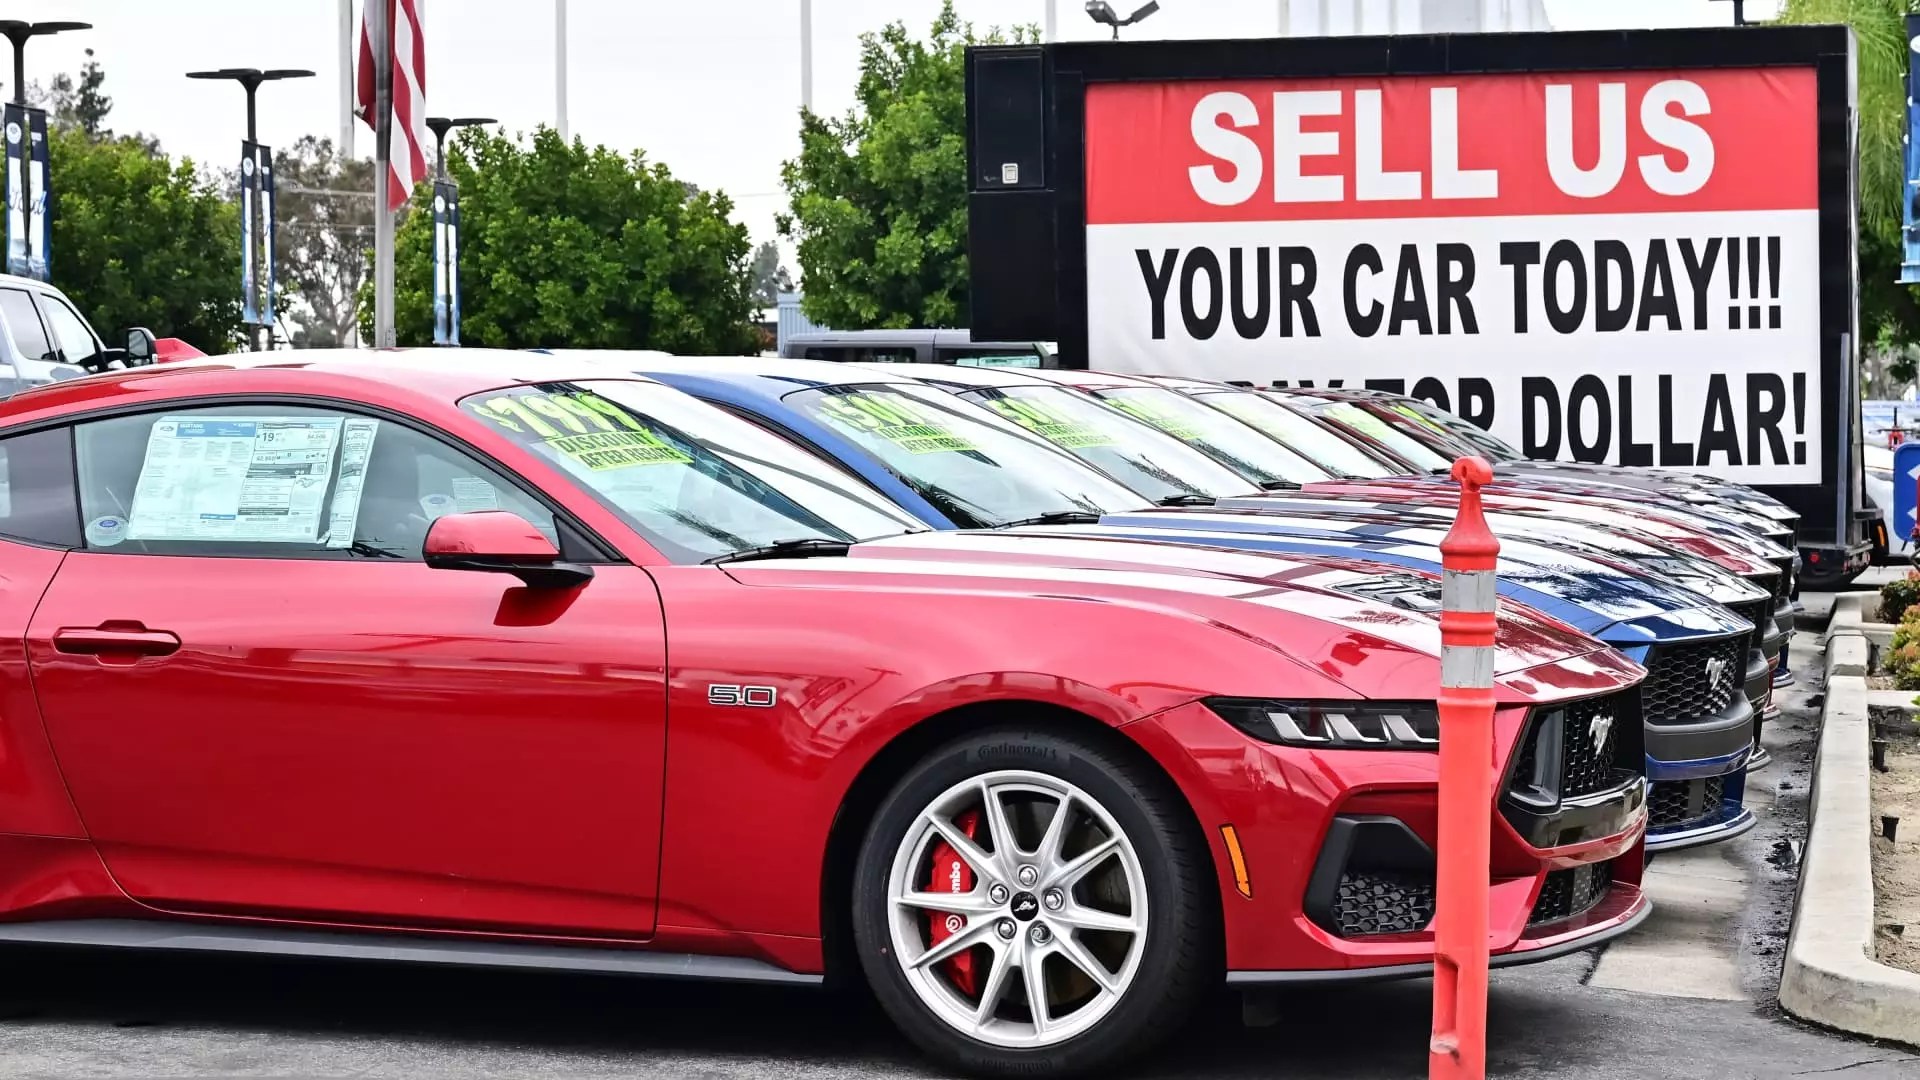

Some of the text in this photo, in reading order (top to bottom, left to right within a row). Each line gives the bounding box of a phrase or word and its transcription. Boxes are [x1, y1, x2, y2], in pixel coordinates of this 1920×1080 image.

[1188, 80, 1716, 206] SELL US
[1136, 235, 1783, 341] YOUR CAR TODAY!!!
[554, 432, 658, 453] DISCOUNT
[1521, 371, 1807, 467] DOLLAR!
[578, 446, 684, 468] AFTER REBATE
[708, 683, 777, 707] 5.0
